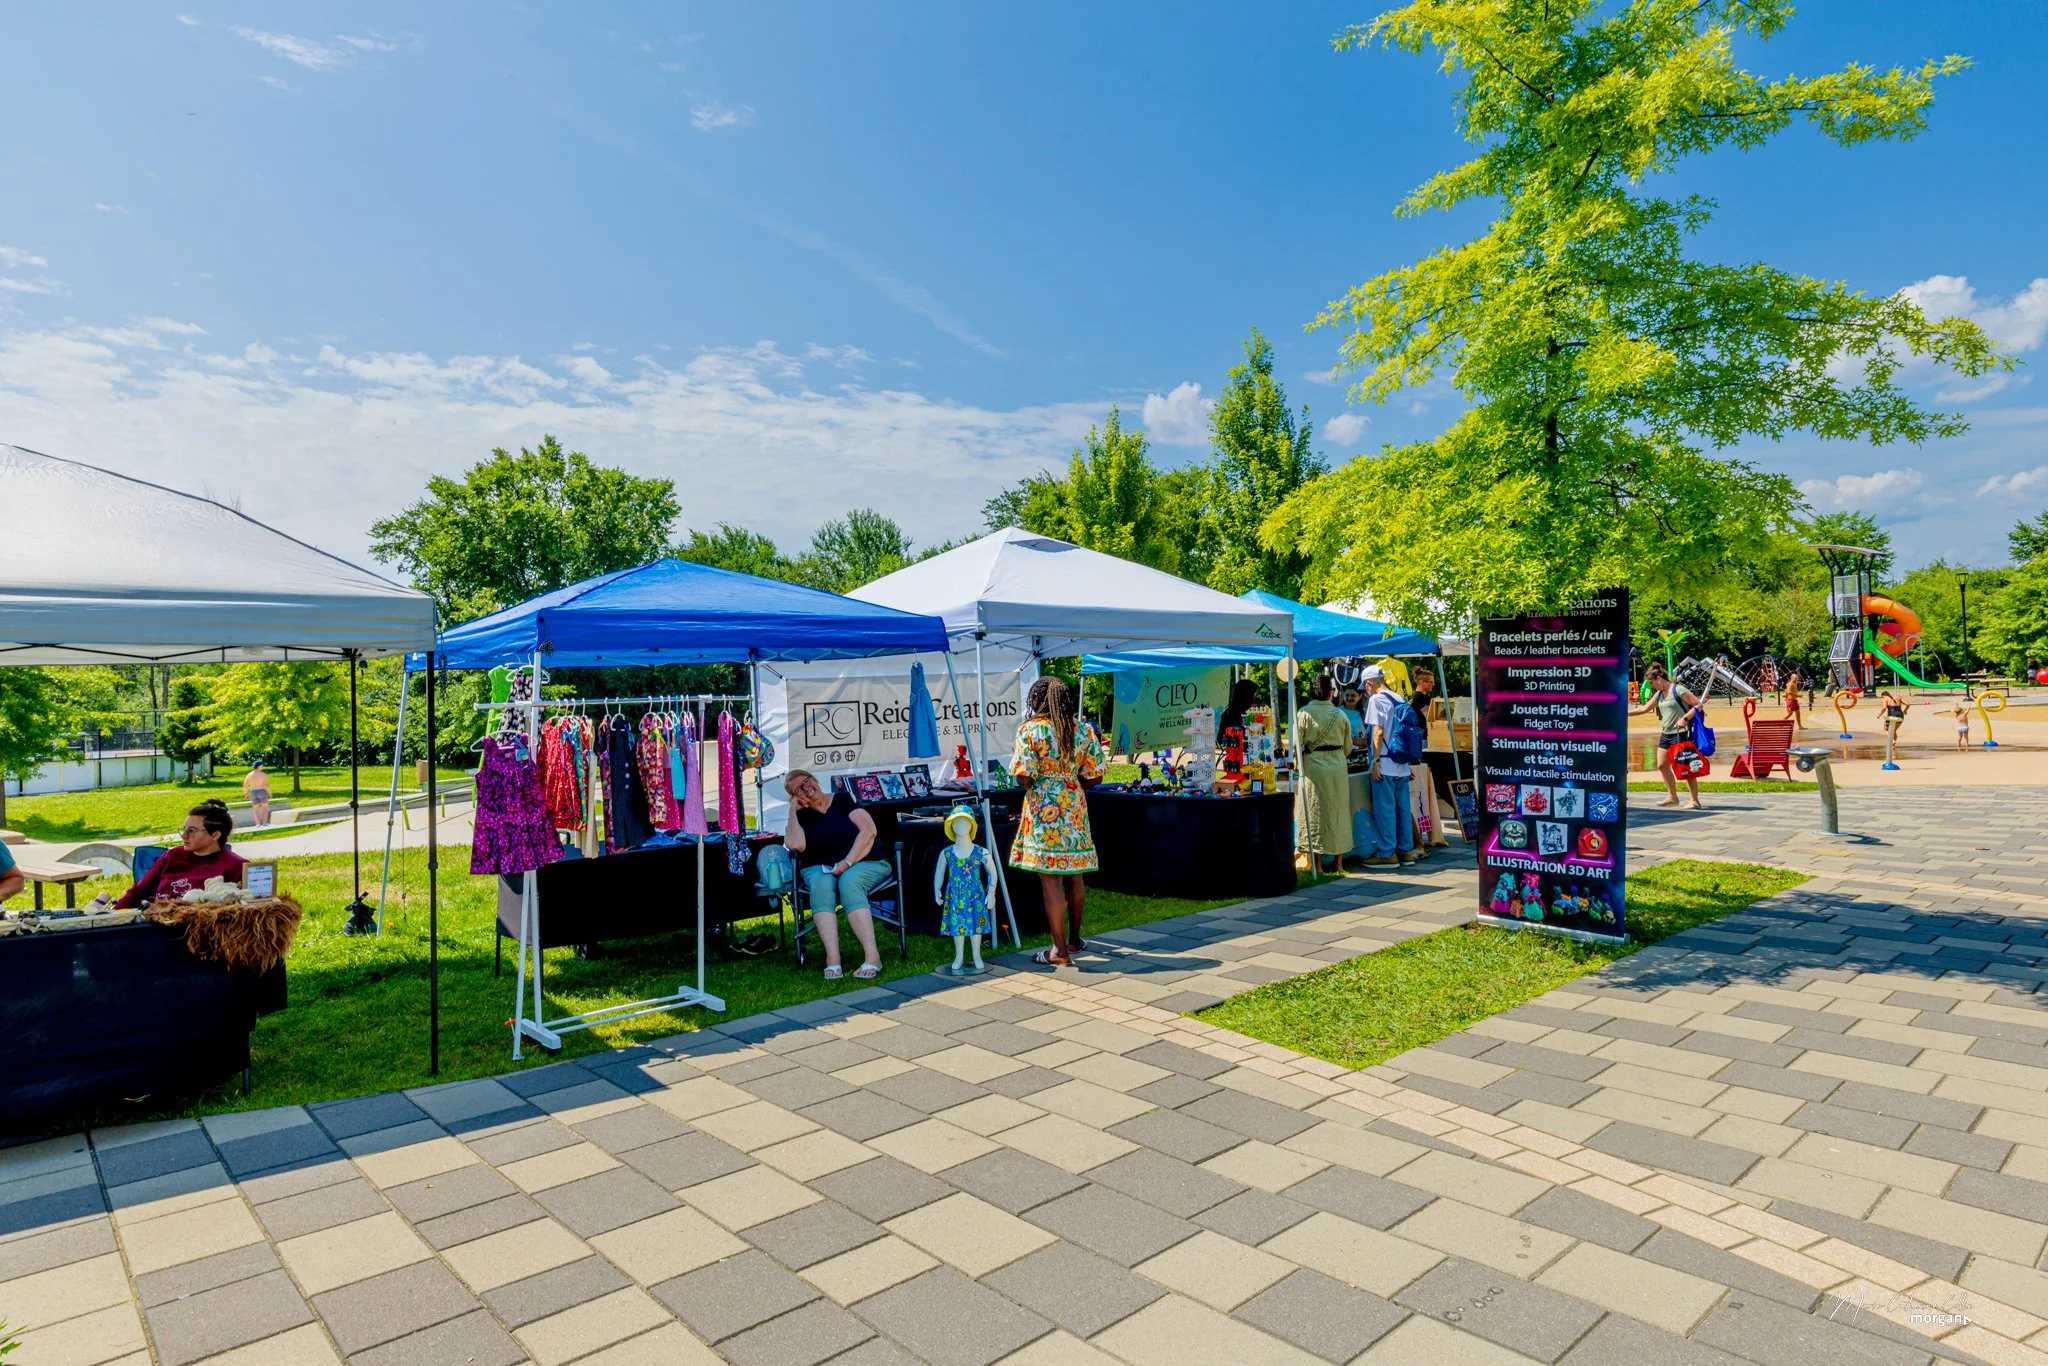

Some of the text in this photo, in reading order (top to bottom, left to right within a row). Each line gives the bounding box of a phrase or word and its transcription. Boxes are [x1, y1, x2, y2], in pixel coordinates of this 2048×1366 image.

[1569, 598, 1617, 609] eations
[1580, 609, 1602, 617] PRINT
[1489, 631, 1542, 642] Bracelets
[1544, 629, 1580, 644] perlés
[1589, 628, 1613, 640] cuir
[1494, 645, 1522, 655] Beads
[1529, 645, 1562, 655] leather
[1562, 644, 1606, 654] bracelets
[1507, 666, 1592, 680] Impression 3D
[1524, 681, 1575, 693] 3D Printing
[931, 698, 1017, 720] reatons
[1510, 704, 1588, 718] Jouets Fidget
[1159, 718, 1192, 729] WELLNESS
[1524, 719, 1574, 731] Fidget Toys
[882, 726, 941, 740] ELEGE
[943, 726, 951, 736] &
[967, 722, 998, 734] PRNT
[1492, 738, 1607, 753] Stimulation visuelle
[1524, 754, 1574, 766] et tactile
[1485, 766, 1615, 782] Visual and tactile stimulation
[1487, 855, 1612, 879] ILLUSTRATION 3D ART
